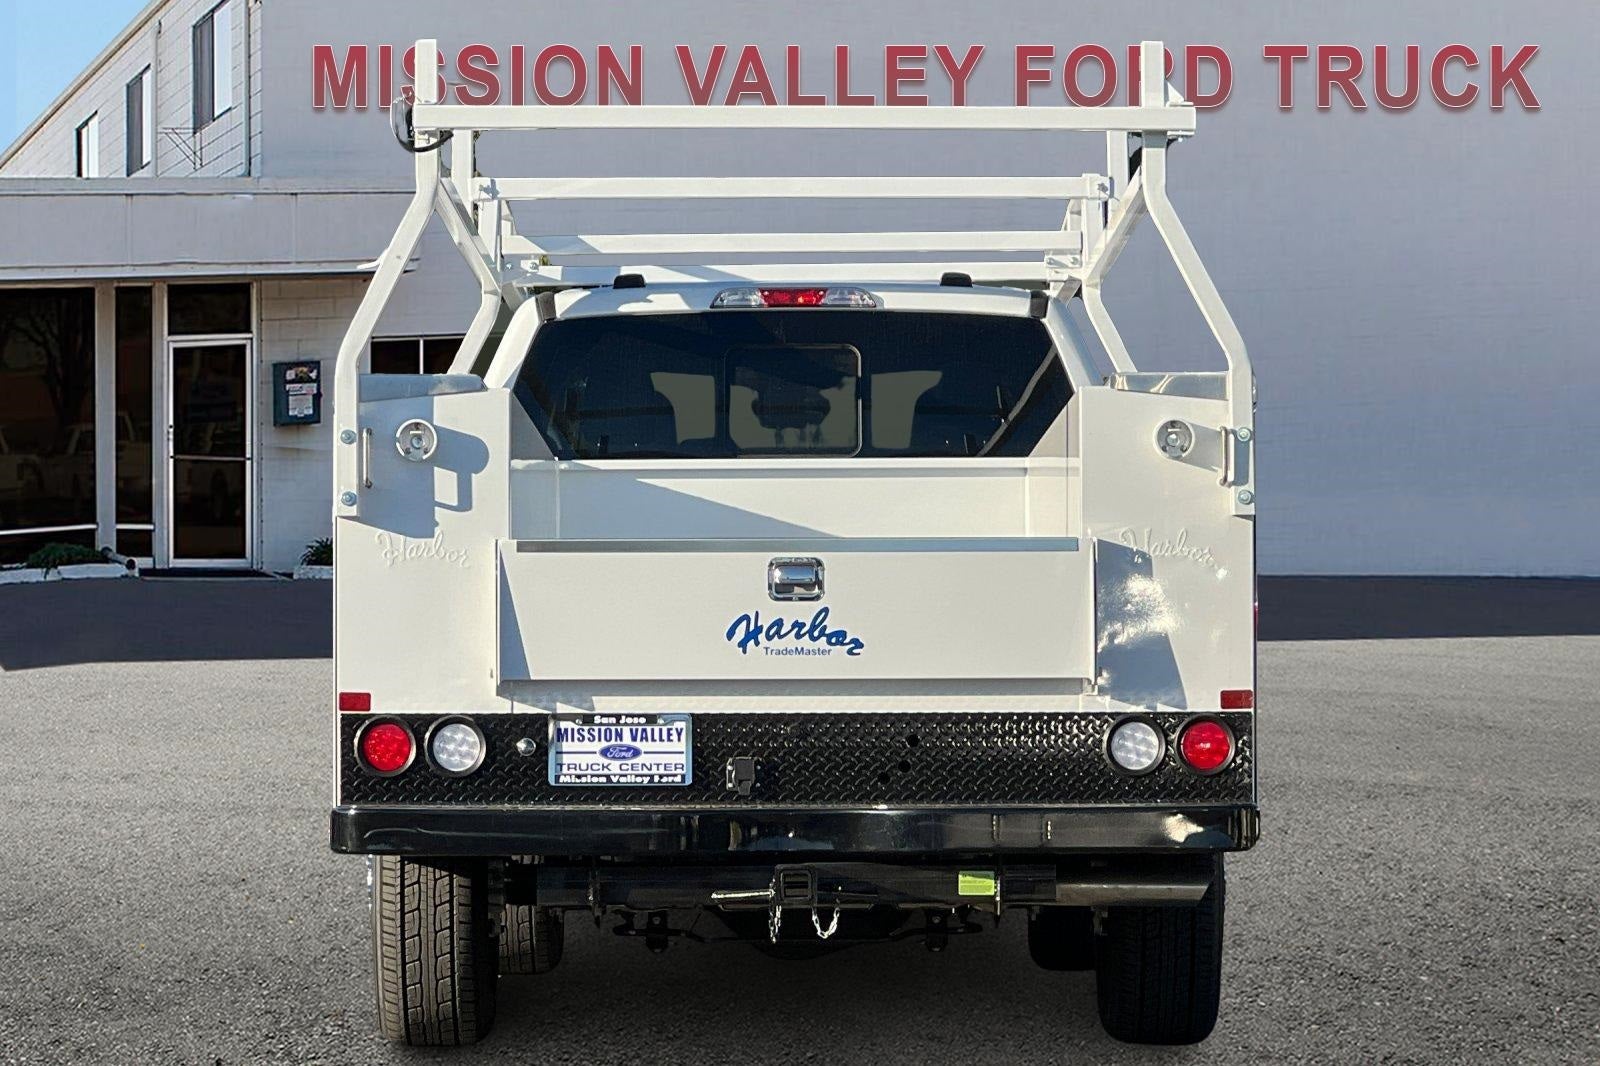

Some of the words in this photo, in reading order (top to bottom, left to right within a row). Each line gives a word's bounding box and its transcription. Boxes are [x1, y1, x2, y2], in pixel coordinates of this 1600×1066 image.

[675, 45, 985, 107] VALLEY
[1263, 44, 1541, 109] TRUCK
[726, 607, 864, 656] Harbor
[763, 647, 832, 656] TradeMaster
[594, 715, 616, 724] San
[556, 727, 623, 742] MISSION
[630, 727, 683, 742] VALLEY
[606, 747, 633, 758] Ford
[556, 763, 612, 772] TRUCK
[619, 763, 685, 772] CENTER
